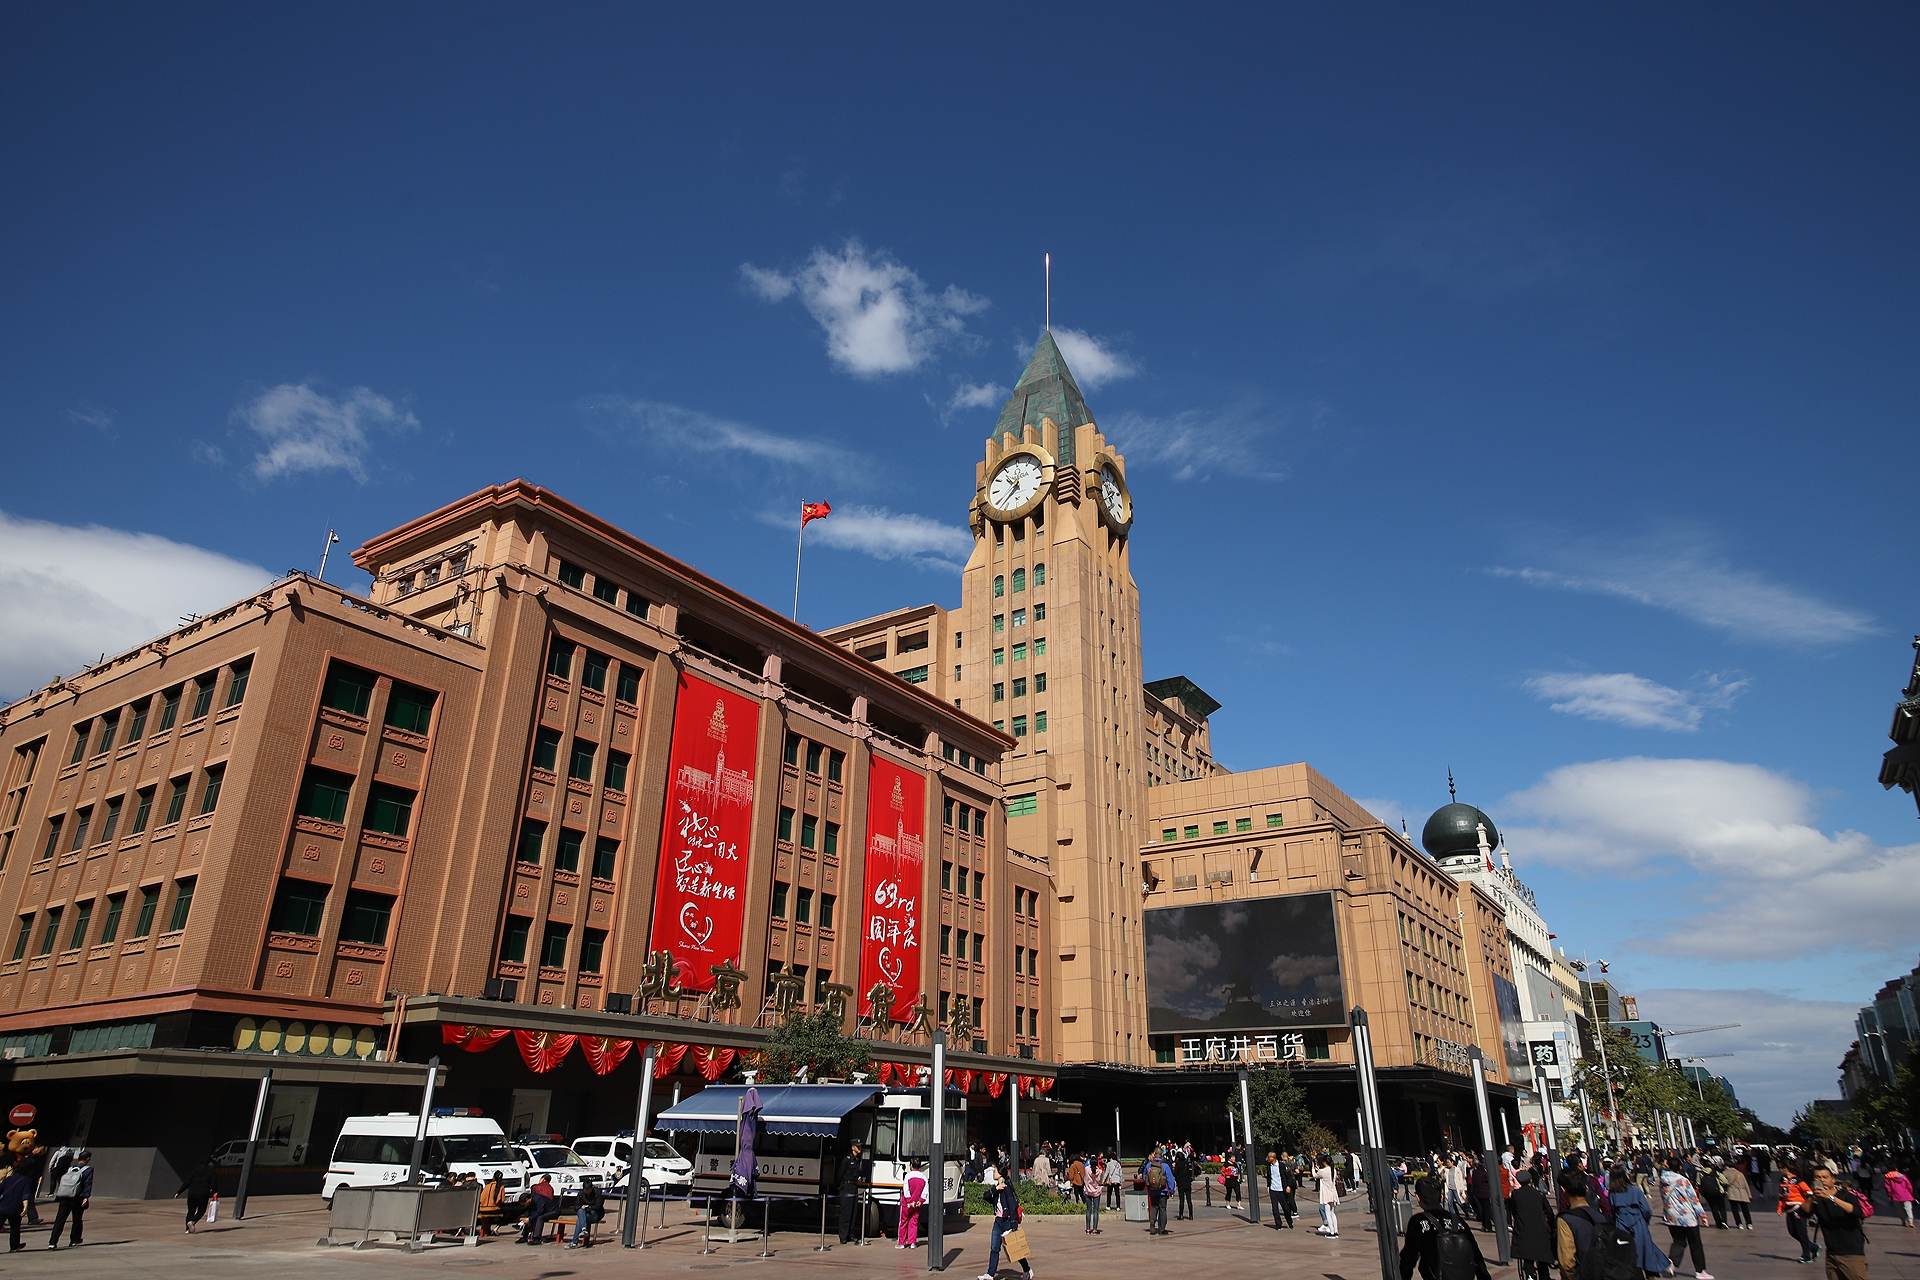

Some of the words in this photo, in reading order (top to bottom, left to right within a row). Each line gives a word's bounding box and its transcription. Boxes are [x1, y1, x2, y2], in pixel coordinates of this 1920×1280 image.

[1180, 1033, 1306, 1061] 王府井百货
[1533, 1044, 1554, 1063] 药
[382, 1171, 398, 1182] 公安
[762, 1164, 804, 1177] OLICE
